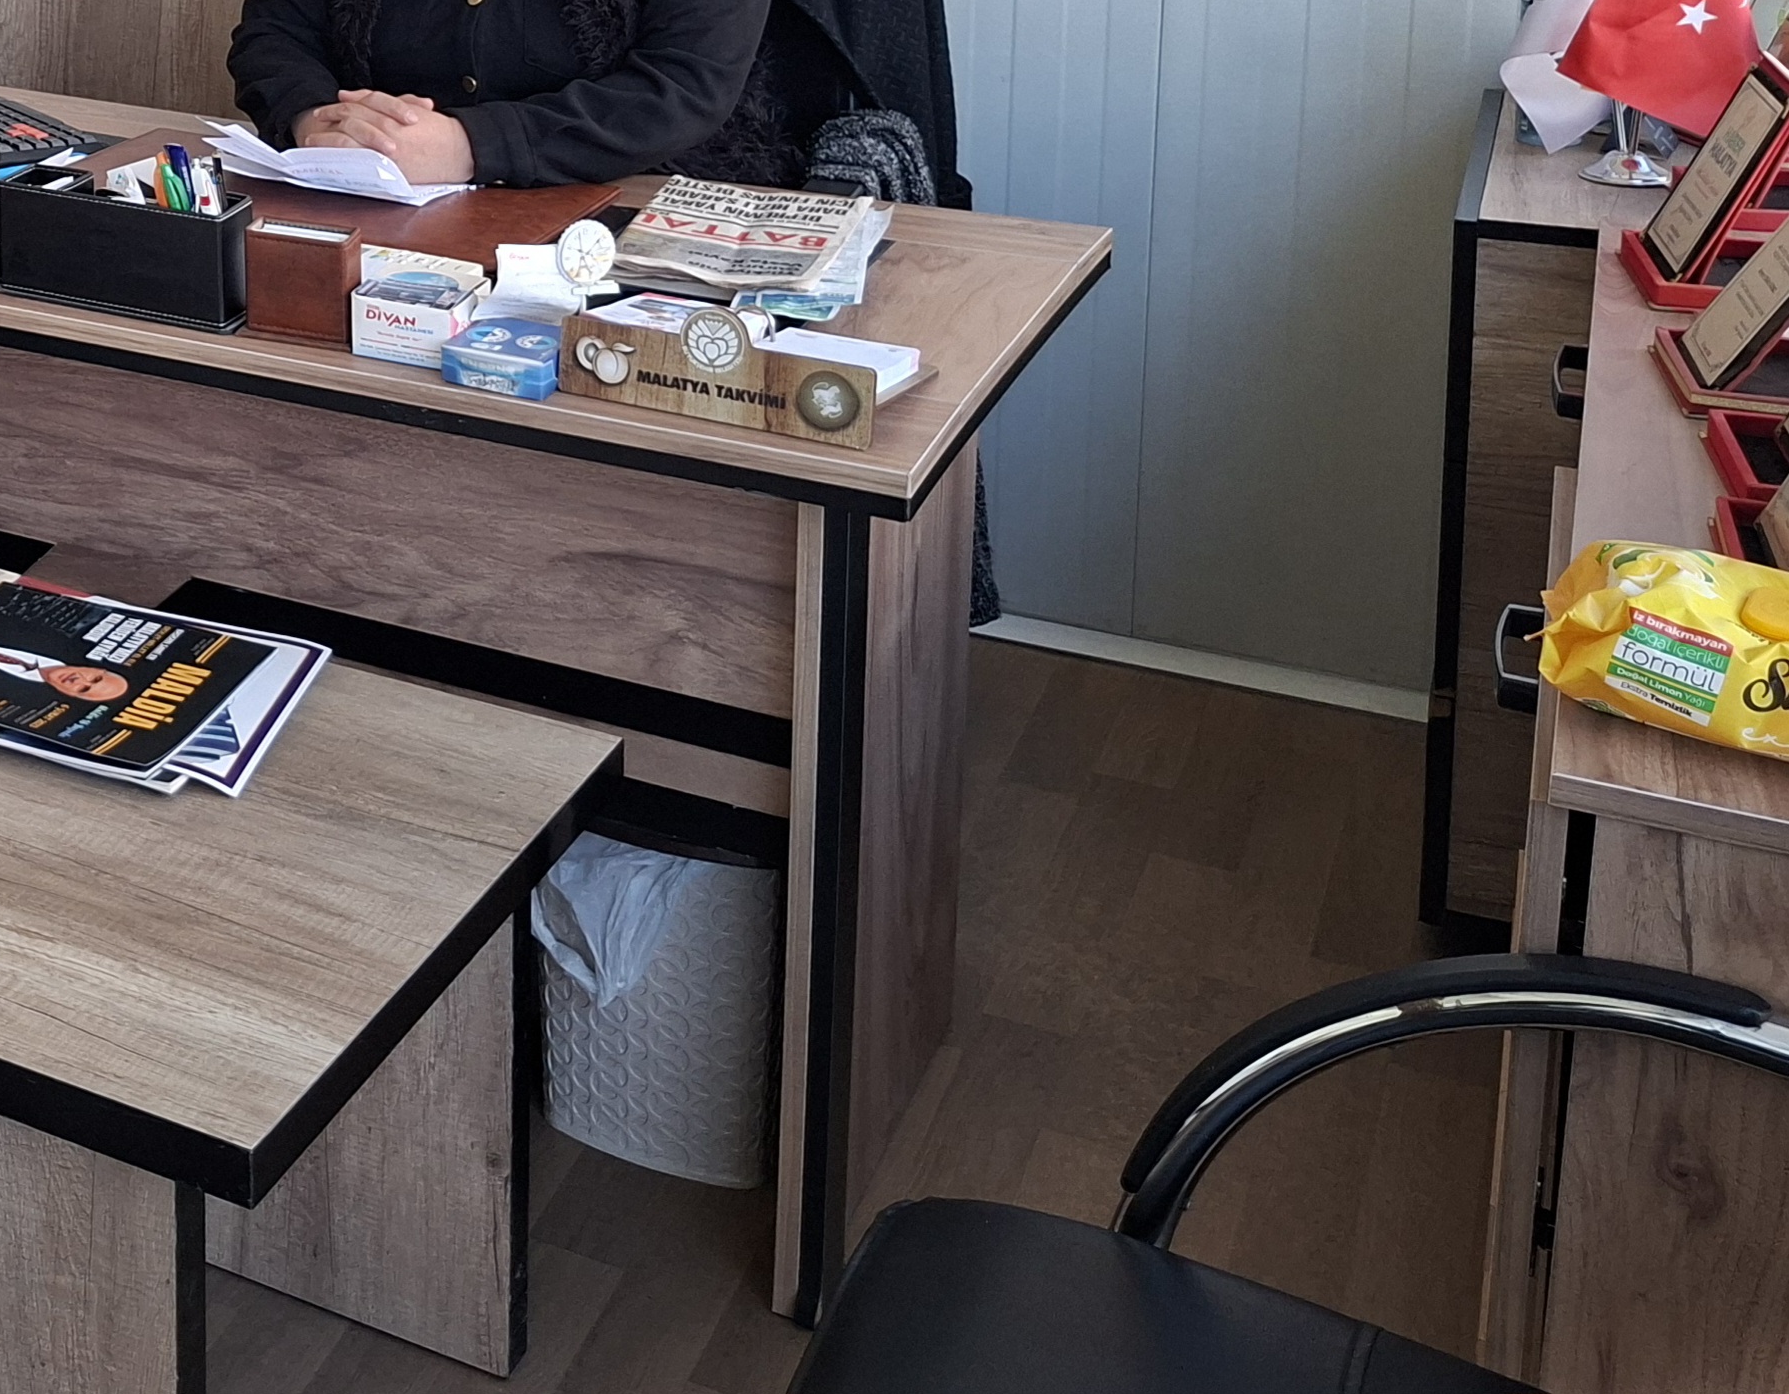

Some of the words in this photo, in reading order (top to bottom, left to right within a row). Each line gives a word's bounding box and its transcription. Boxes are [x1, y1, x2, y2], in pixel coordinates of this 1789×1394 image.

[796, 205, 849, 216] DAHA
[636, 369, 711, 396] MALATYA
[714, 383, 788, 410] TAKVİMİ
[1616, 667, 1649, 685] Doğal
[1649, 677, 1684, 700] Limon
[1623, 640, 1715, 693] formül
[111, 661, 212, 730] MALDİA
[1620, 681, 1649, 699] Ekstra
[1649, 693, 1693, 718] Temizlik
